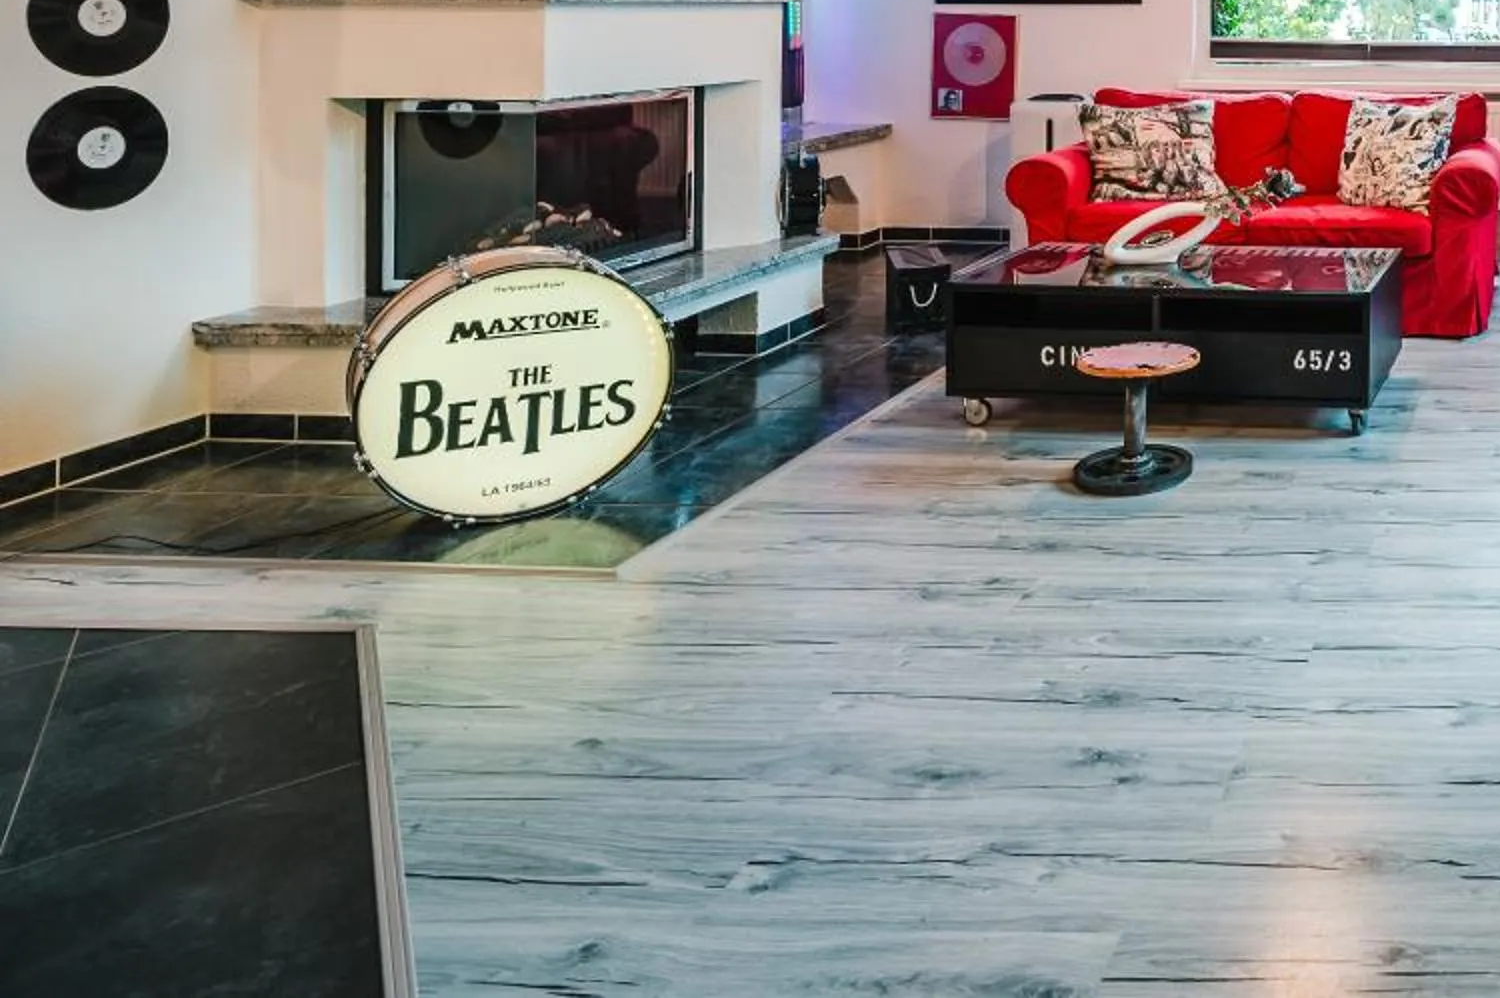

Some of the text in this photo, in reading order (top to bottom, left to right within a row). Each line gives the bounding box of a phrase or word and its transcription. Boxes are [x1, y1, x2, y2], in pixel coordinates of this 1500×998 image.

[446, 308, 599, 344] MAXTONE
[1041, 345, 1091, 366] CIN
[1294, 349, 1351, 372] 65/3
[508, 364, 553, 388] THE
[395, 379, 637, 460] BEATLES
